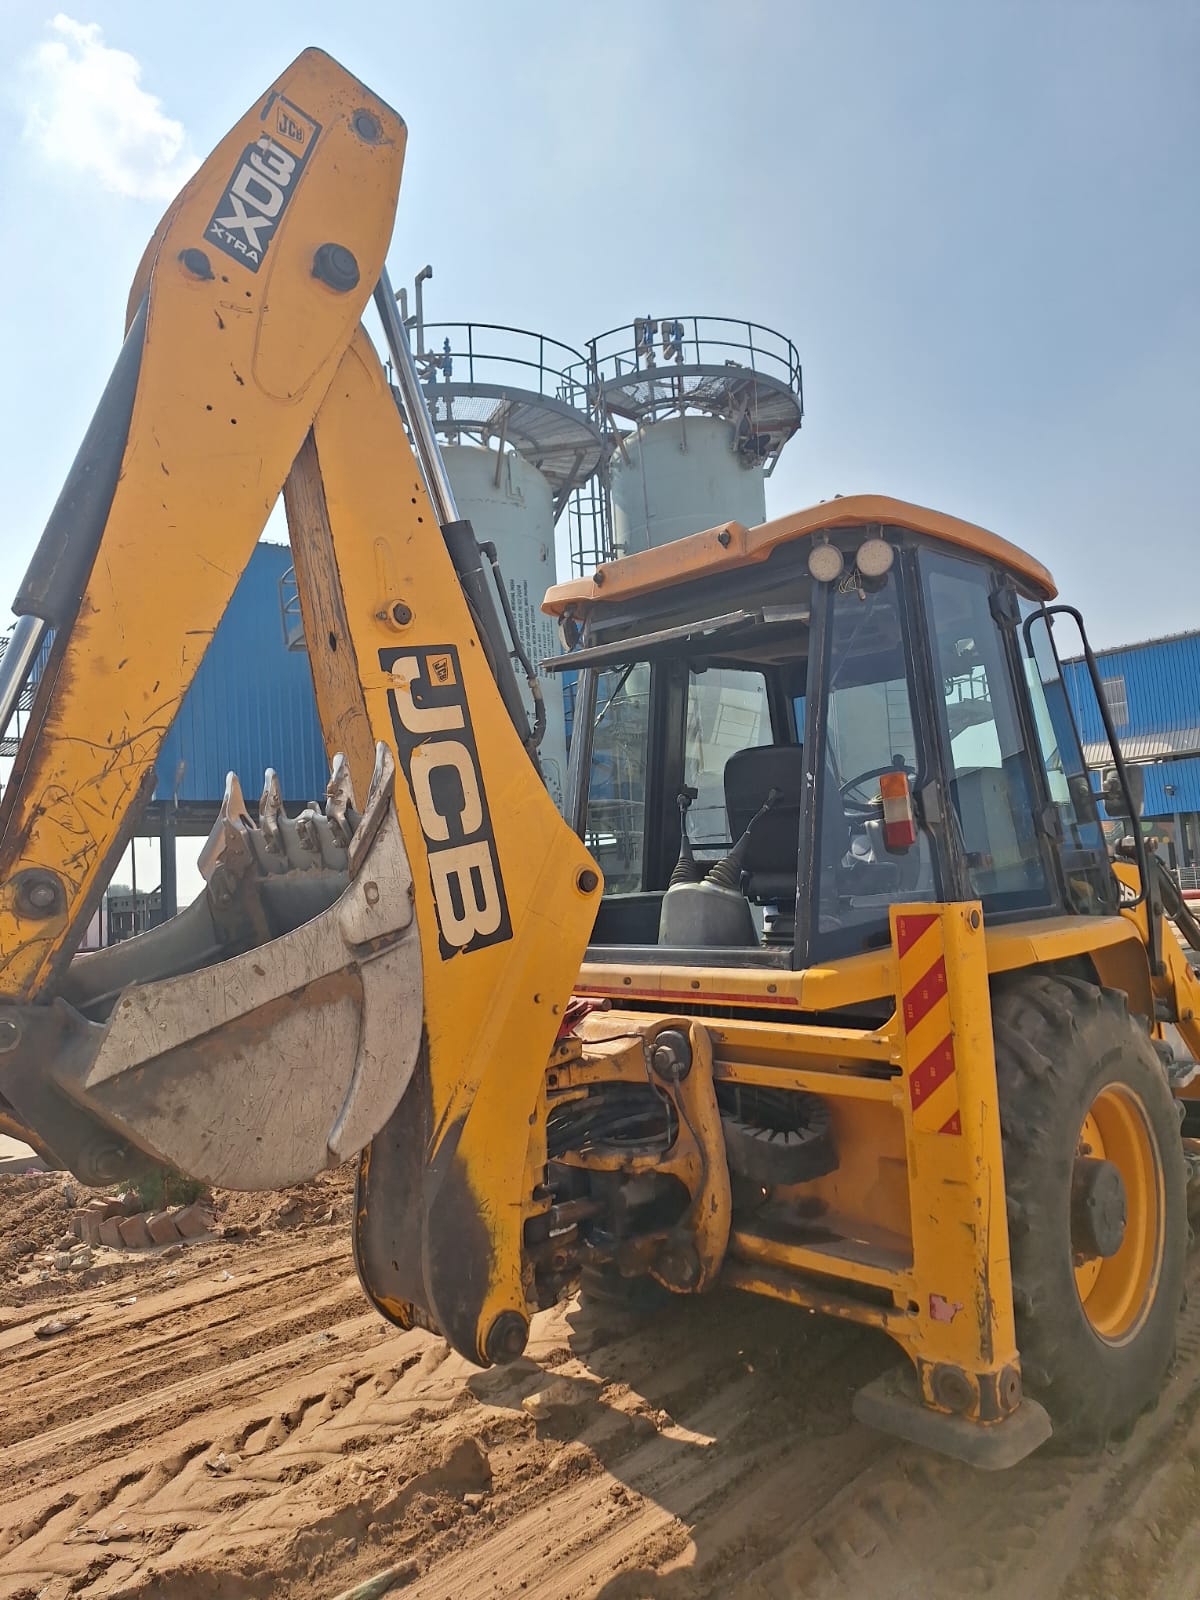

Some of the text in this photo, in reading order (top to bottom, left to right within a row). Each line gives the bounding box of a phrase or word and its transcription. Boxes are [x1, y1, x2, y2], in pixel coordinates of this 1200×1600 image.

[279, 112, 303, 141] JCB
[210, 222, 259, 264] XTRA
[433, 660, 448, 681] JCB
[391, 656, 501, 947] JCB
